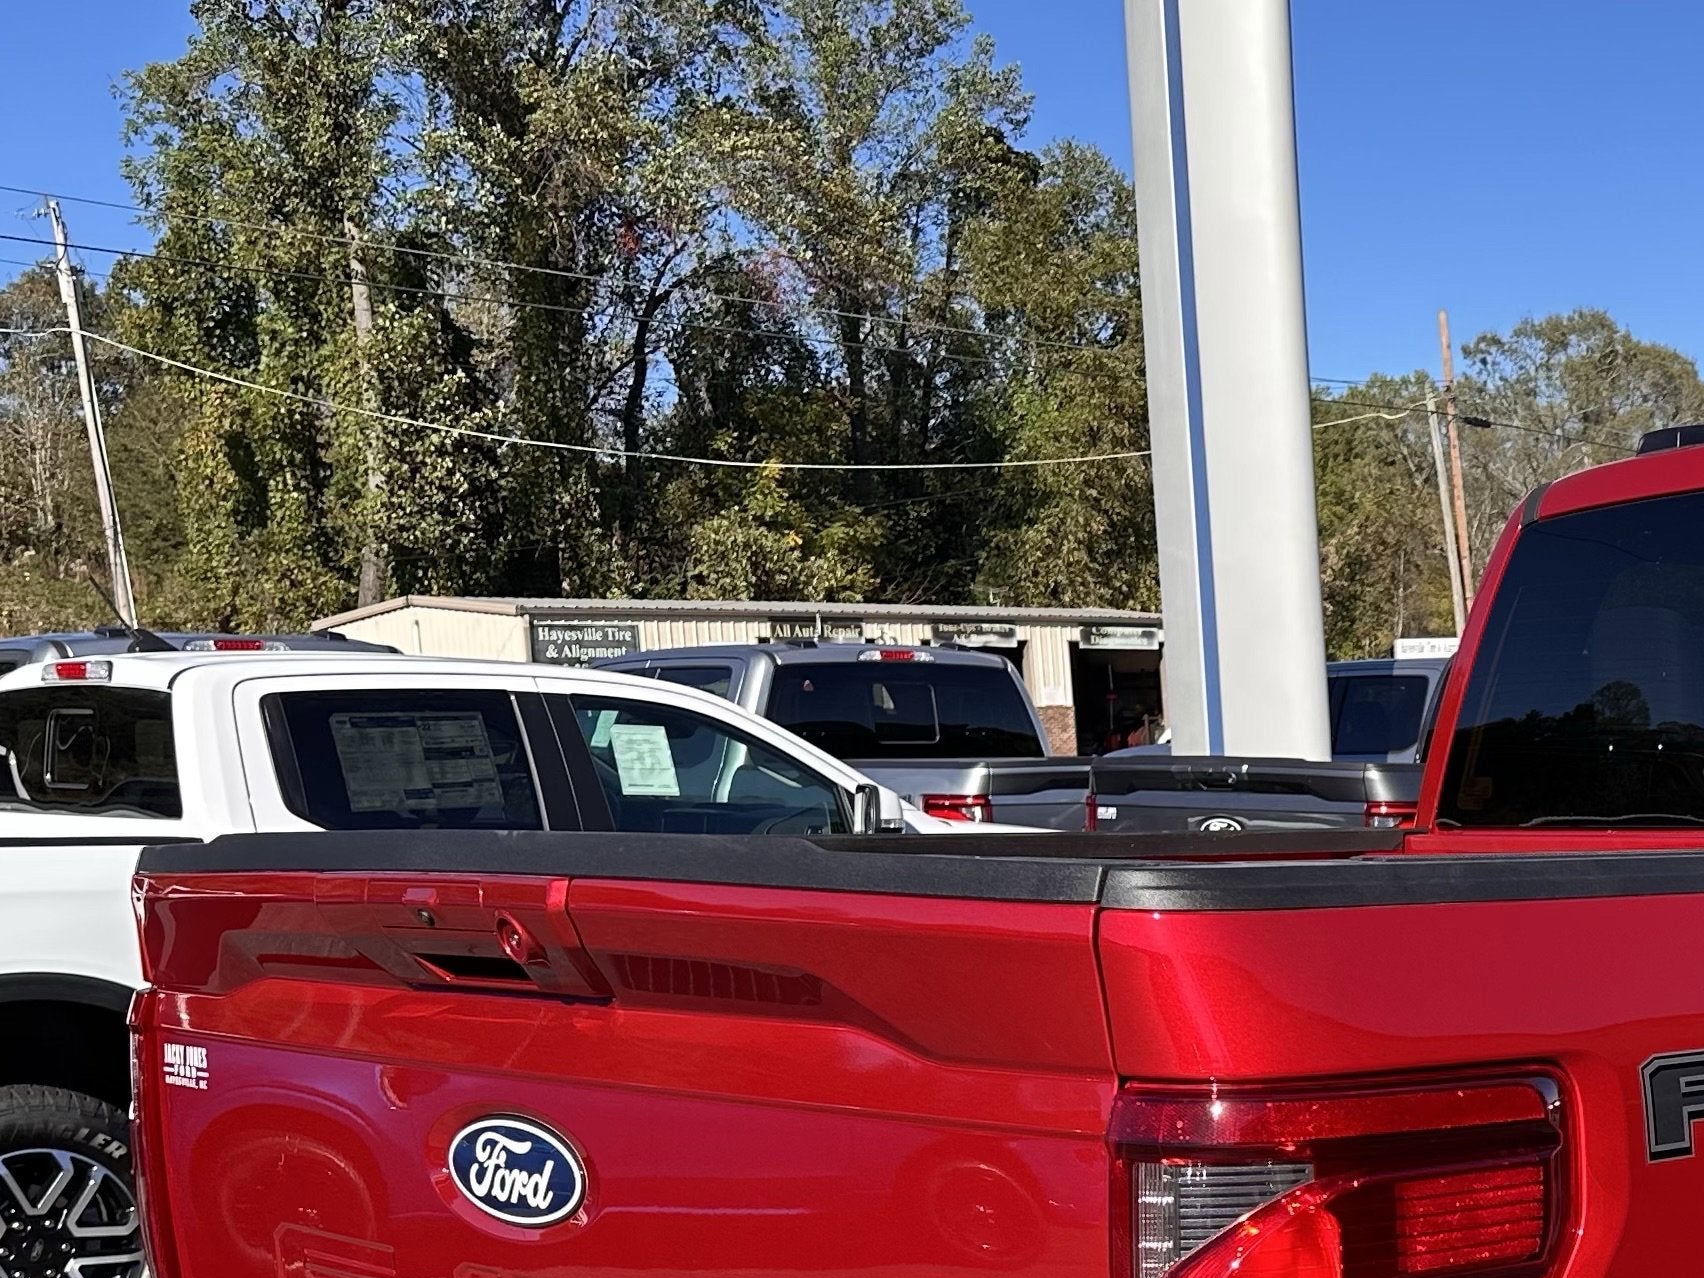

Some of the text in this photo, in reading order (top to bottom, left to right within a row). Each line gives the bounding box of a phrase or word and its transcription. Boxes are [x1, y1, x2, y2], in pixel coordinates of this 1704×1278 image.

[537, 627, 632, 644] Hayesville Tire
[773, 623, 861, 641] All Aut Repair
[546, 643, 627, 661] & Alignment
[470, 1131, 555, 1210] Ford
